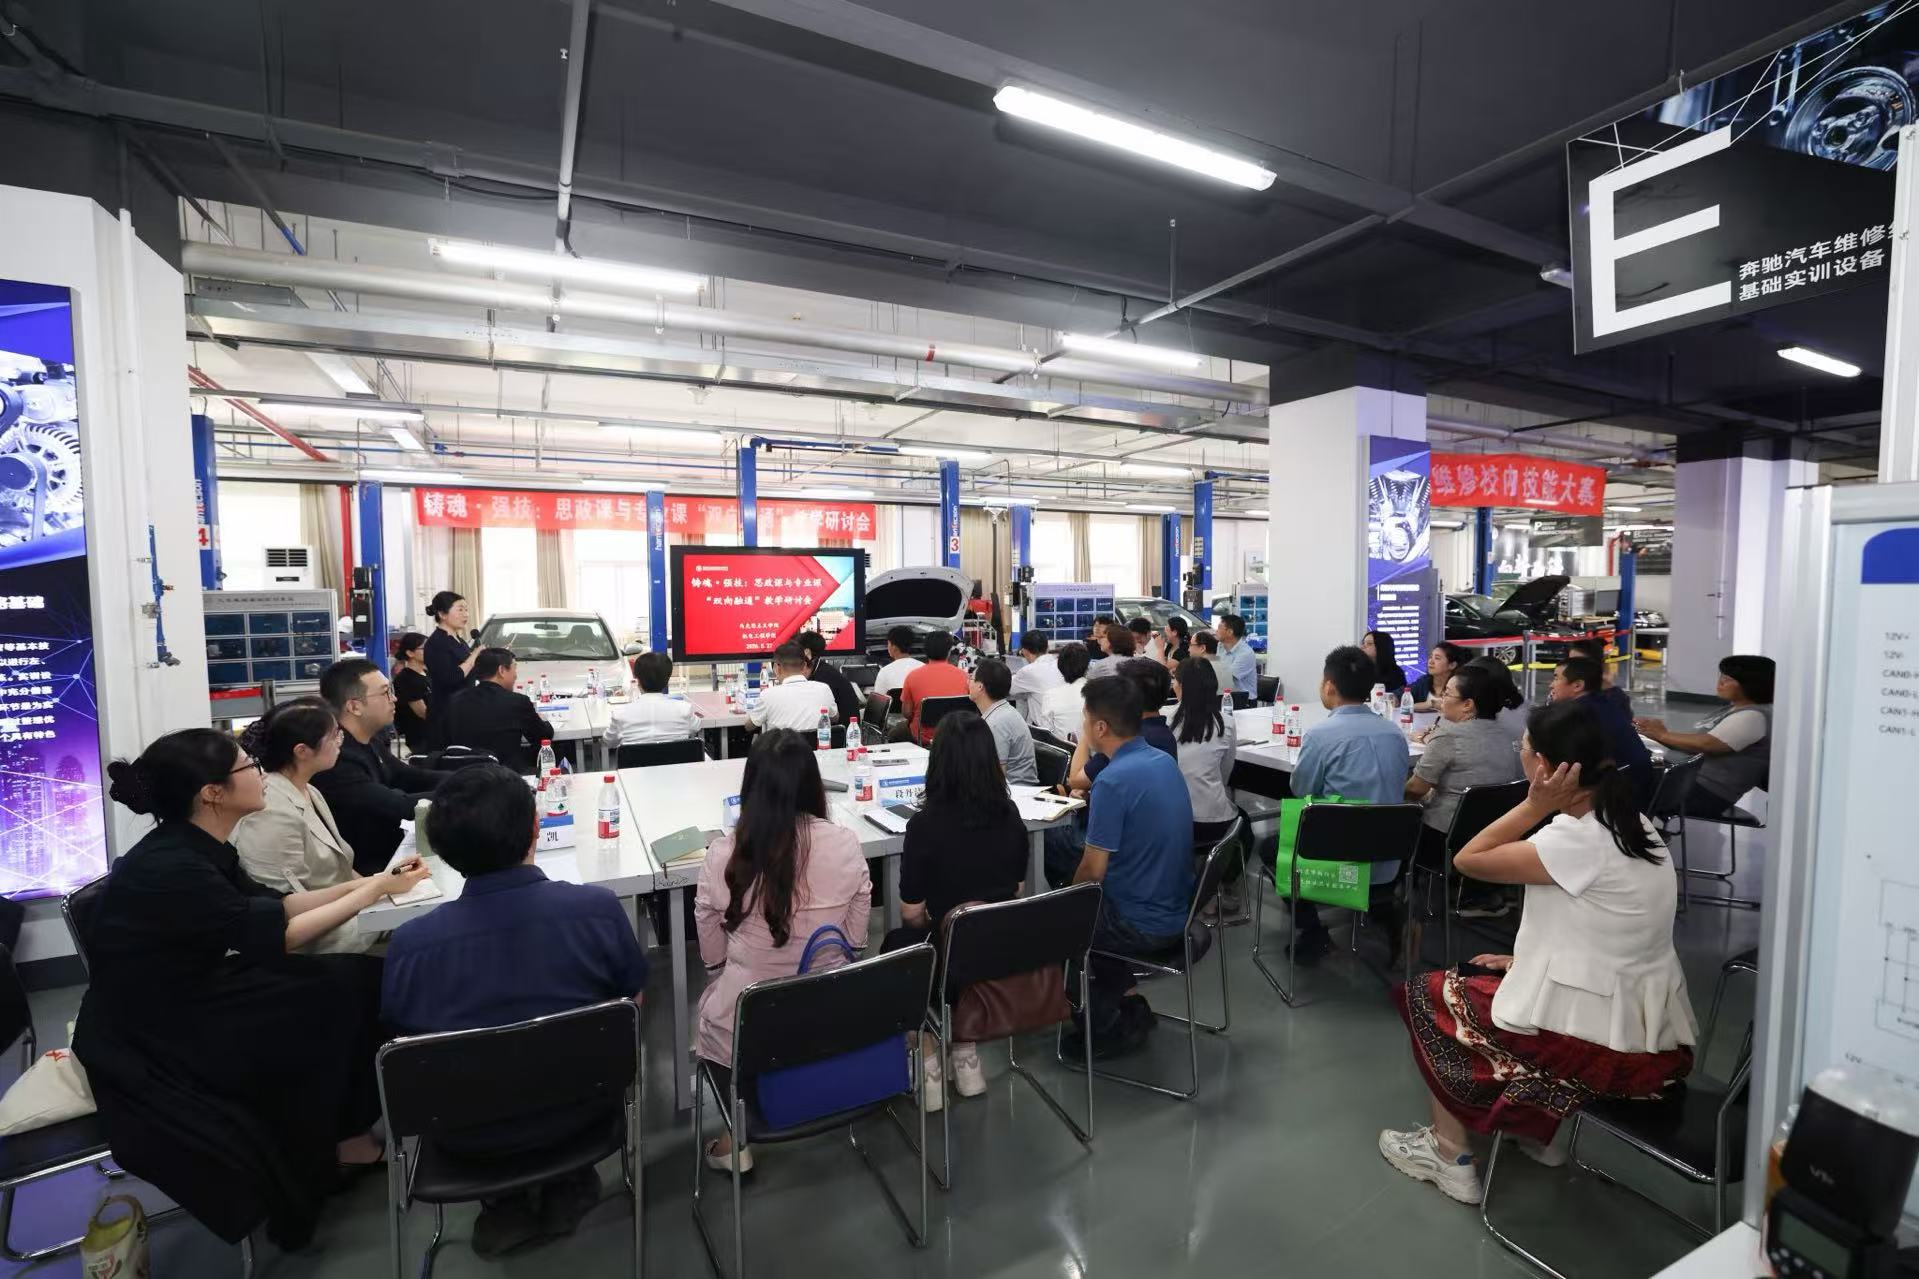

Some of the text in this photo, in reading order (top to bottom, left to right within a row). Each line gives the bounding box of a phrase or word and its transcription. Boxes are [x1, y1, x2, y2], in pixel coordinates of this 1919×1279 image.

[1588, 124, 1732, 338] E
[1739, 248, 1885, 302] 基础实训设备
[950, 537, 959, 551] 3
